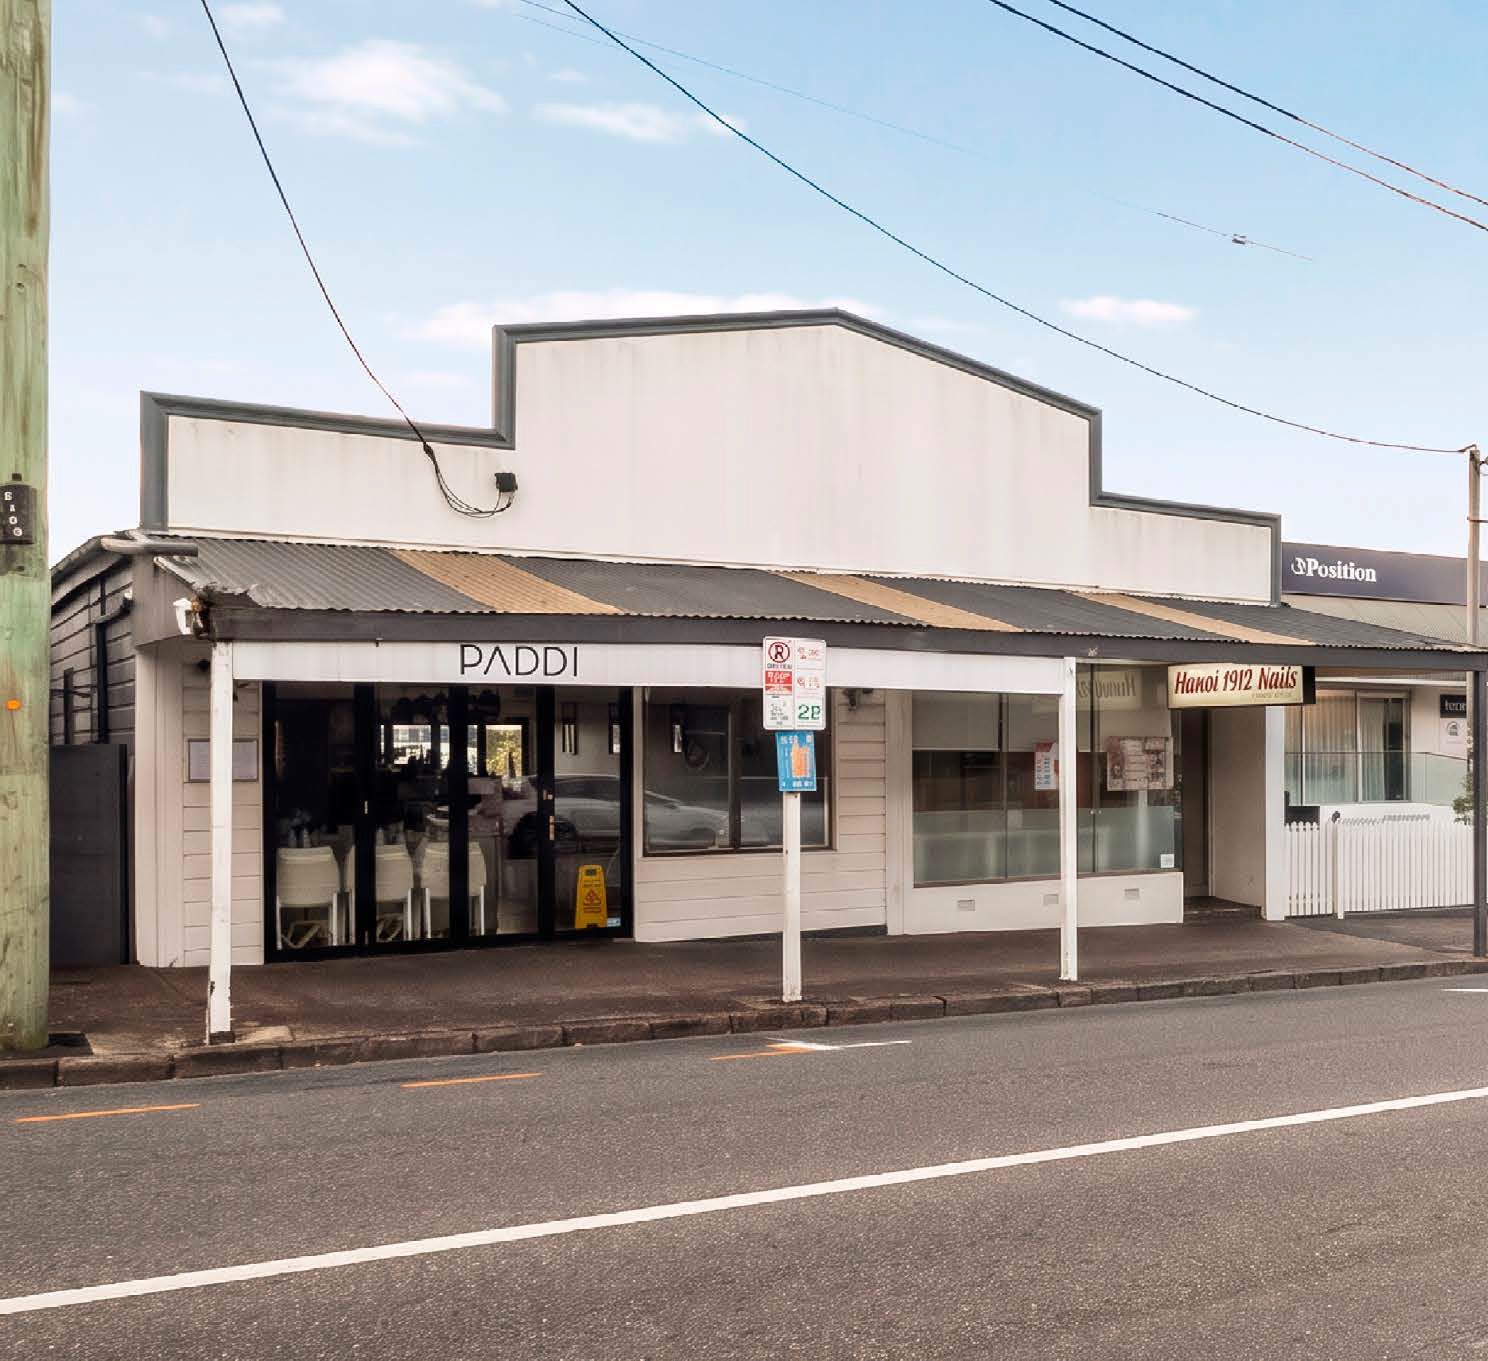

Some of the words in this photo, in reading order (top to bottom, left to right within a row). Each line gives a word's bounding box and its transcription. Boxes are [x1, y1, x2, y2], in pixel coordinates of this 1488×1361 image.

[1305, 557, 1377, 582] Position
[460, 644, 578, 677] PADDI
[1175, 669, 1220, 695] Hanoi
[1222, 668, 1253, 692] 1912
[1257, 665, 1298, 690] Nails
